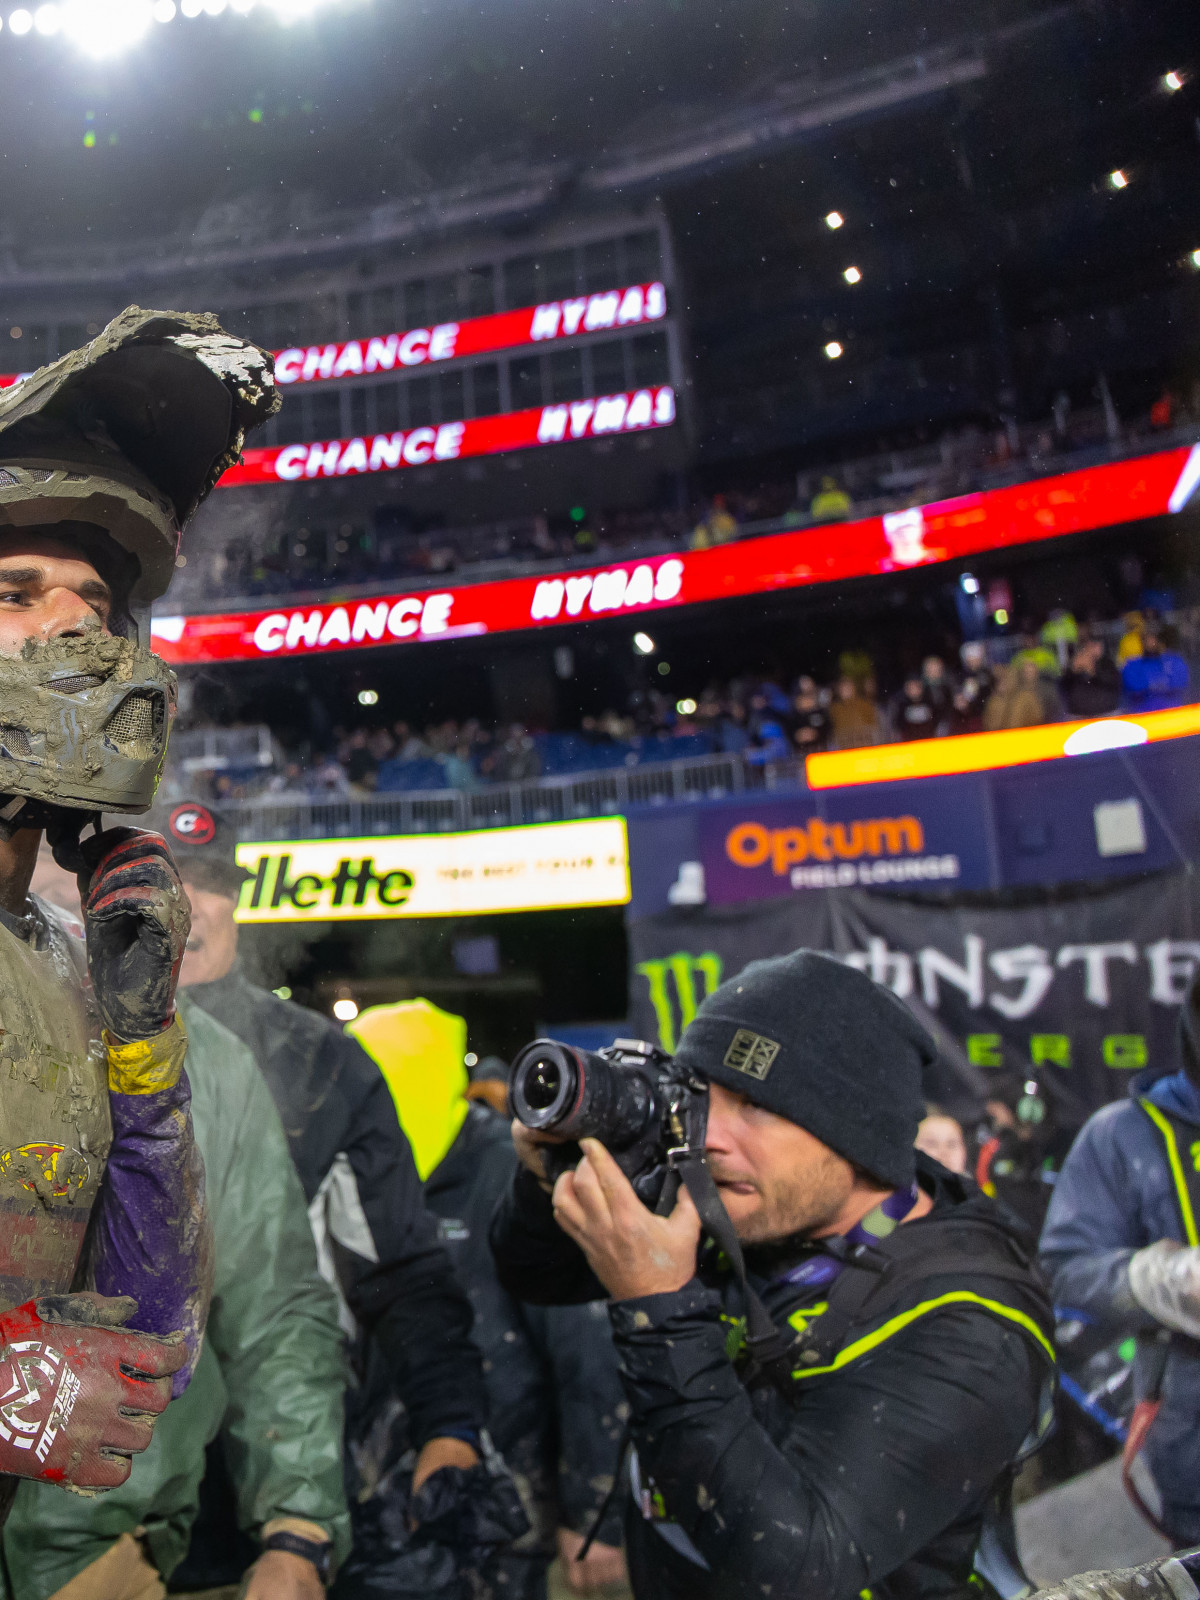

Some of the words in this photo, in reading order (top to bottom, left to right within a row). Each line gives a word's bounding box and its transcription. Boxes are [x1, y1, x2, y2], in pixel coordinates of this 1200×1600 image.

[275, 323, 460, 384] CHANCE
[531, 282, 667, 341] HYMAS
[275, 422, 465, 480] CHANCE
[538, 386, 675, 442] HYMAS
[253, 594, 455, 651] CHANCE
[531, 560, 684, 620] HYMAS
[250, 855, 412, 908] llette
[726, 815, 924, 876] Optum
[791, 863, 857, 890] FIELD
[859, 854, 960, 884] LOUNGE
[840, 933, 1200, 1019] ONSTE
[966, 1033, 1149, 1068] ERG
